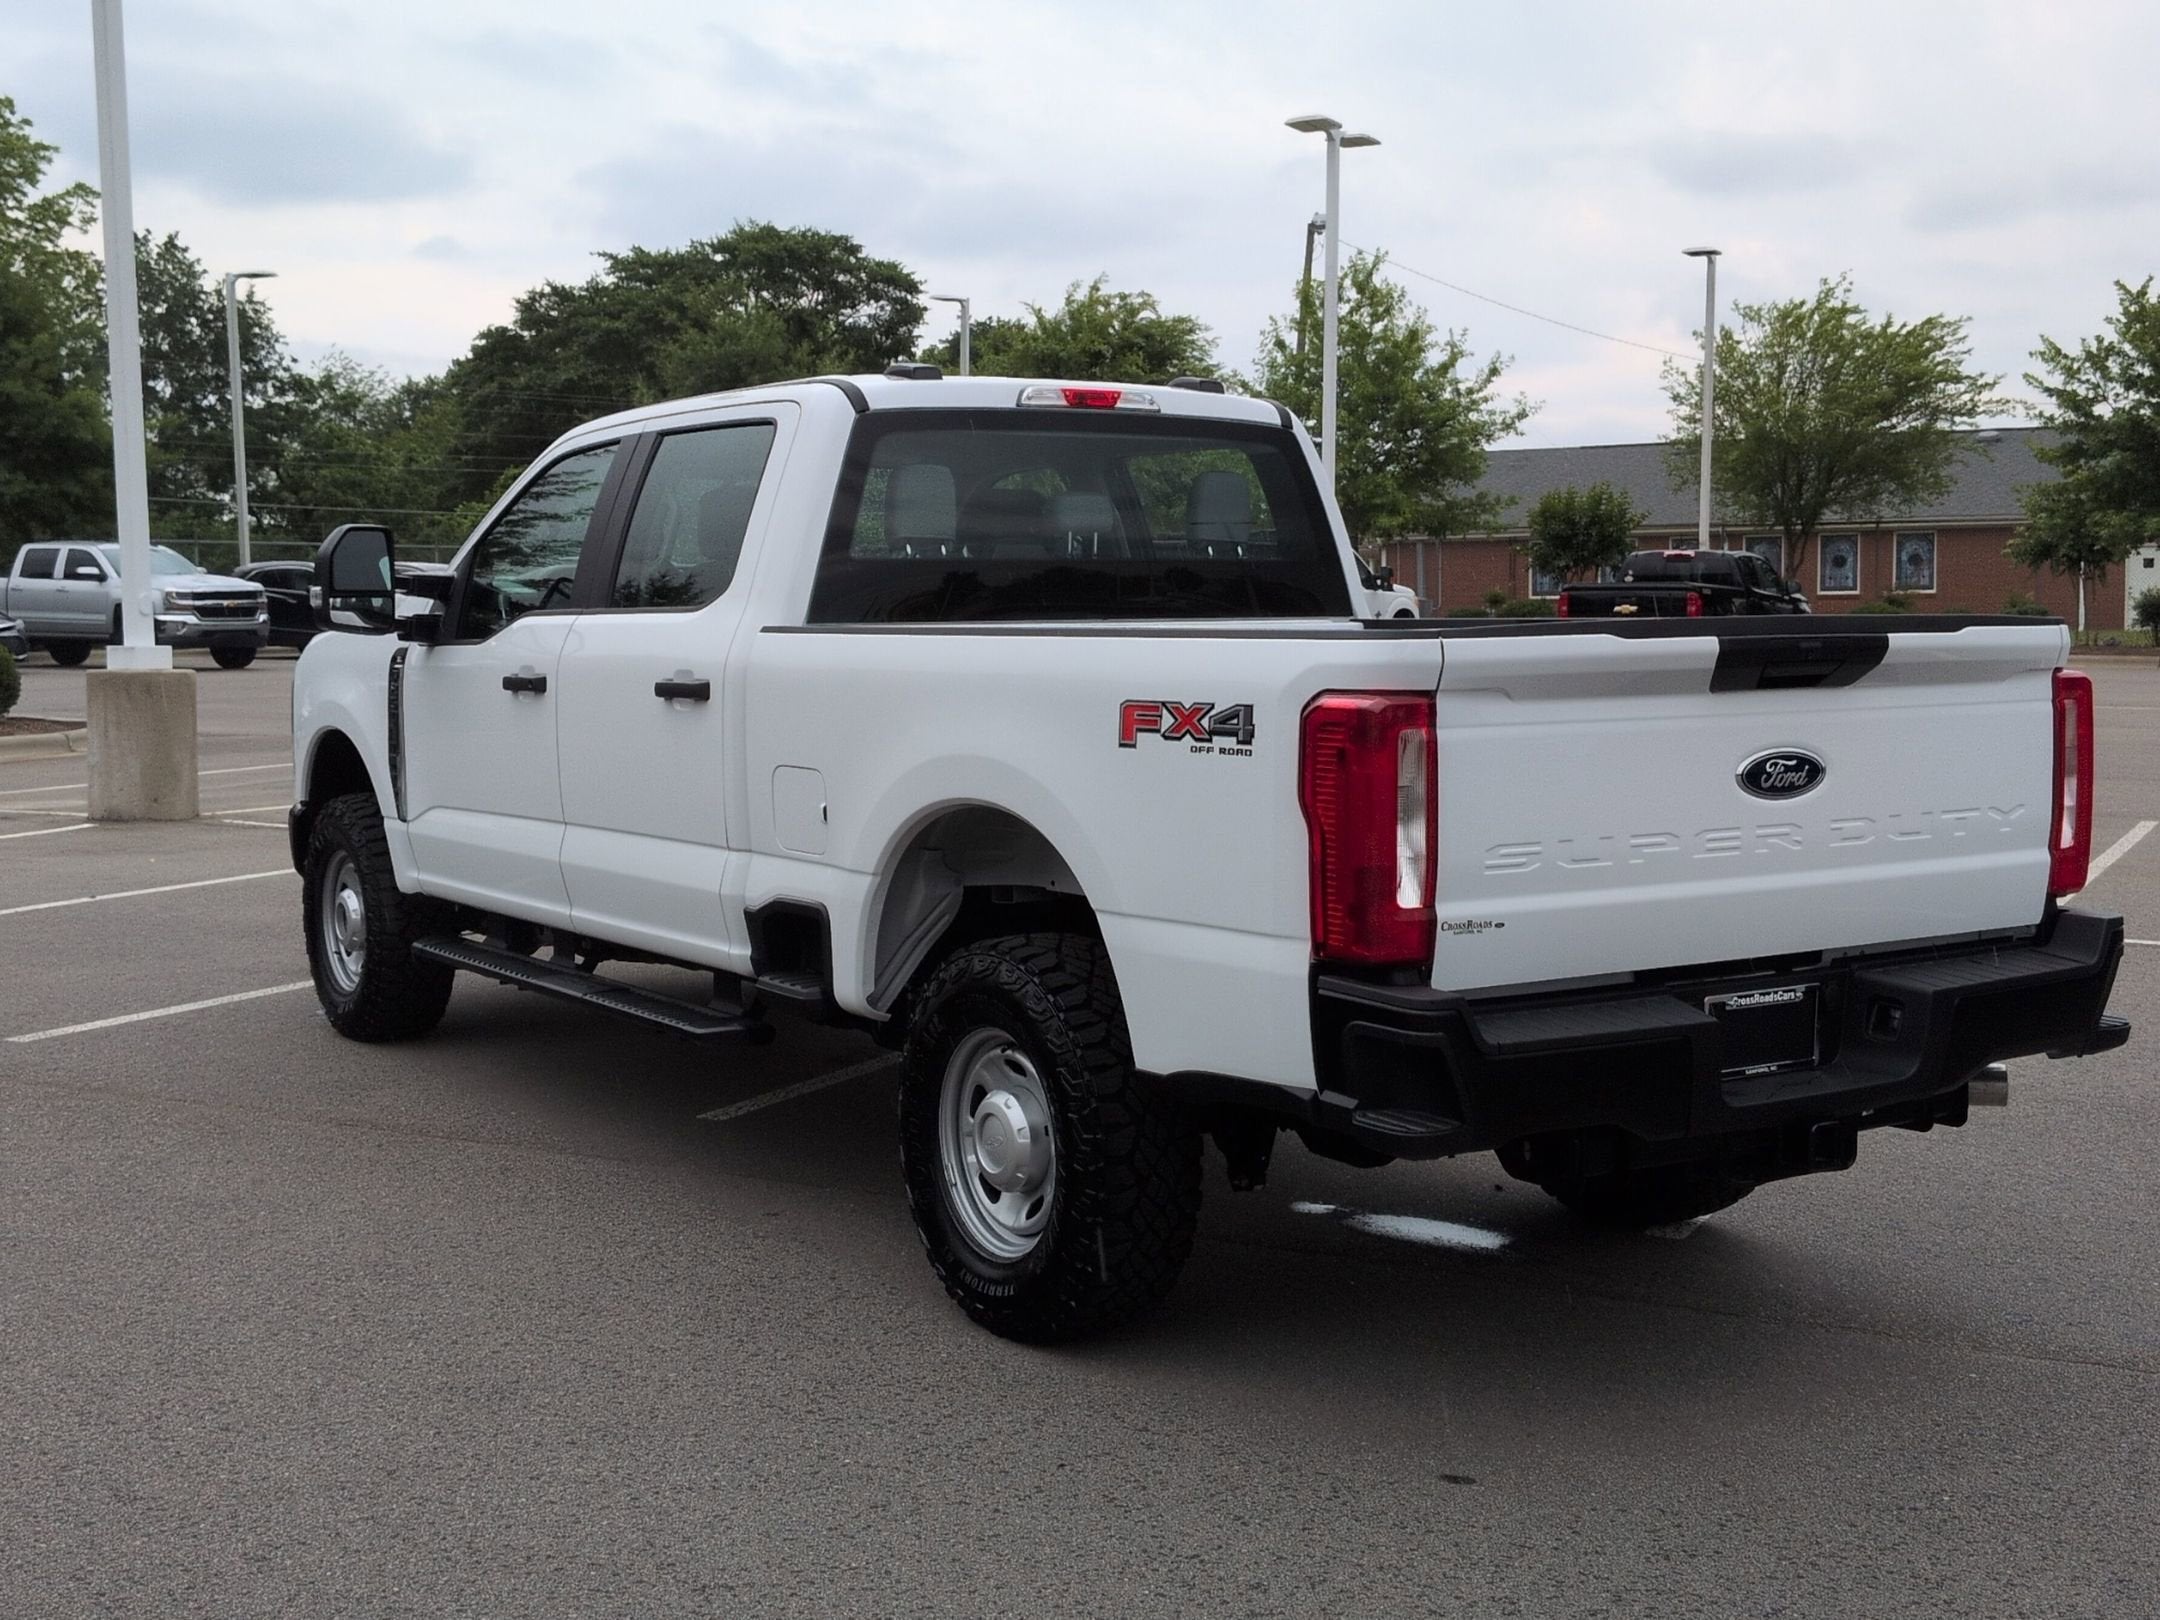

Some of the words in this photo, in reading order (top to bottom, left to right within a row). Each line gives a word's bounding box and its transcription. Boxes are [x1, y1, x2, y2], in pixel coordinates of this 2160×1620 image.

[1119, 700, 1255, 749] FX4
[1190, 745, 1214, 754] OFF
[1219, 747, 1253, 757] ROAD
[1761, 759, 1809, 788] Ford
[1484, 824, 1802, 875] SUPER
[1829, 804, 2025, 847] DUTY
[958, 1269, 1015, 1297] TERRITORY
